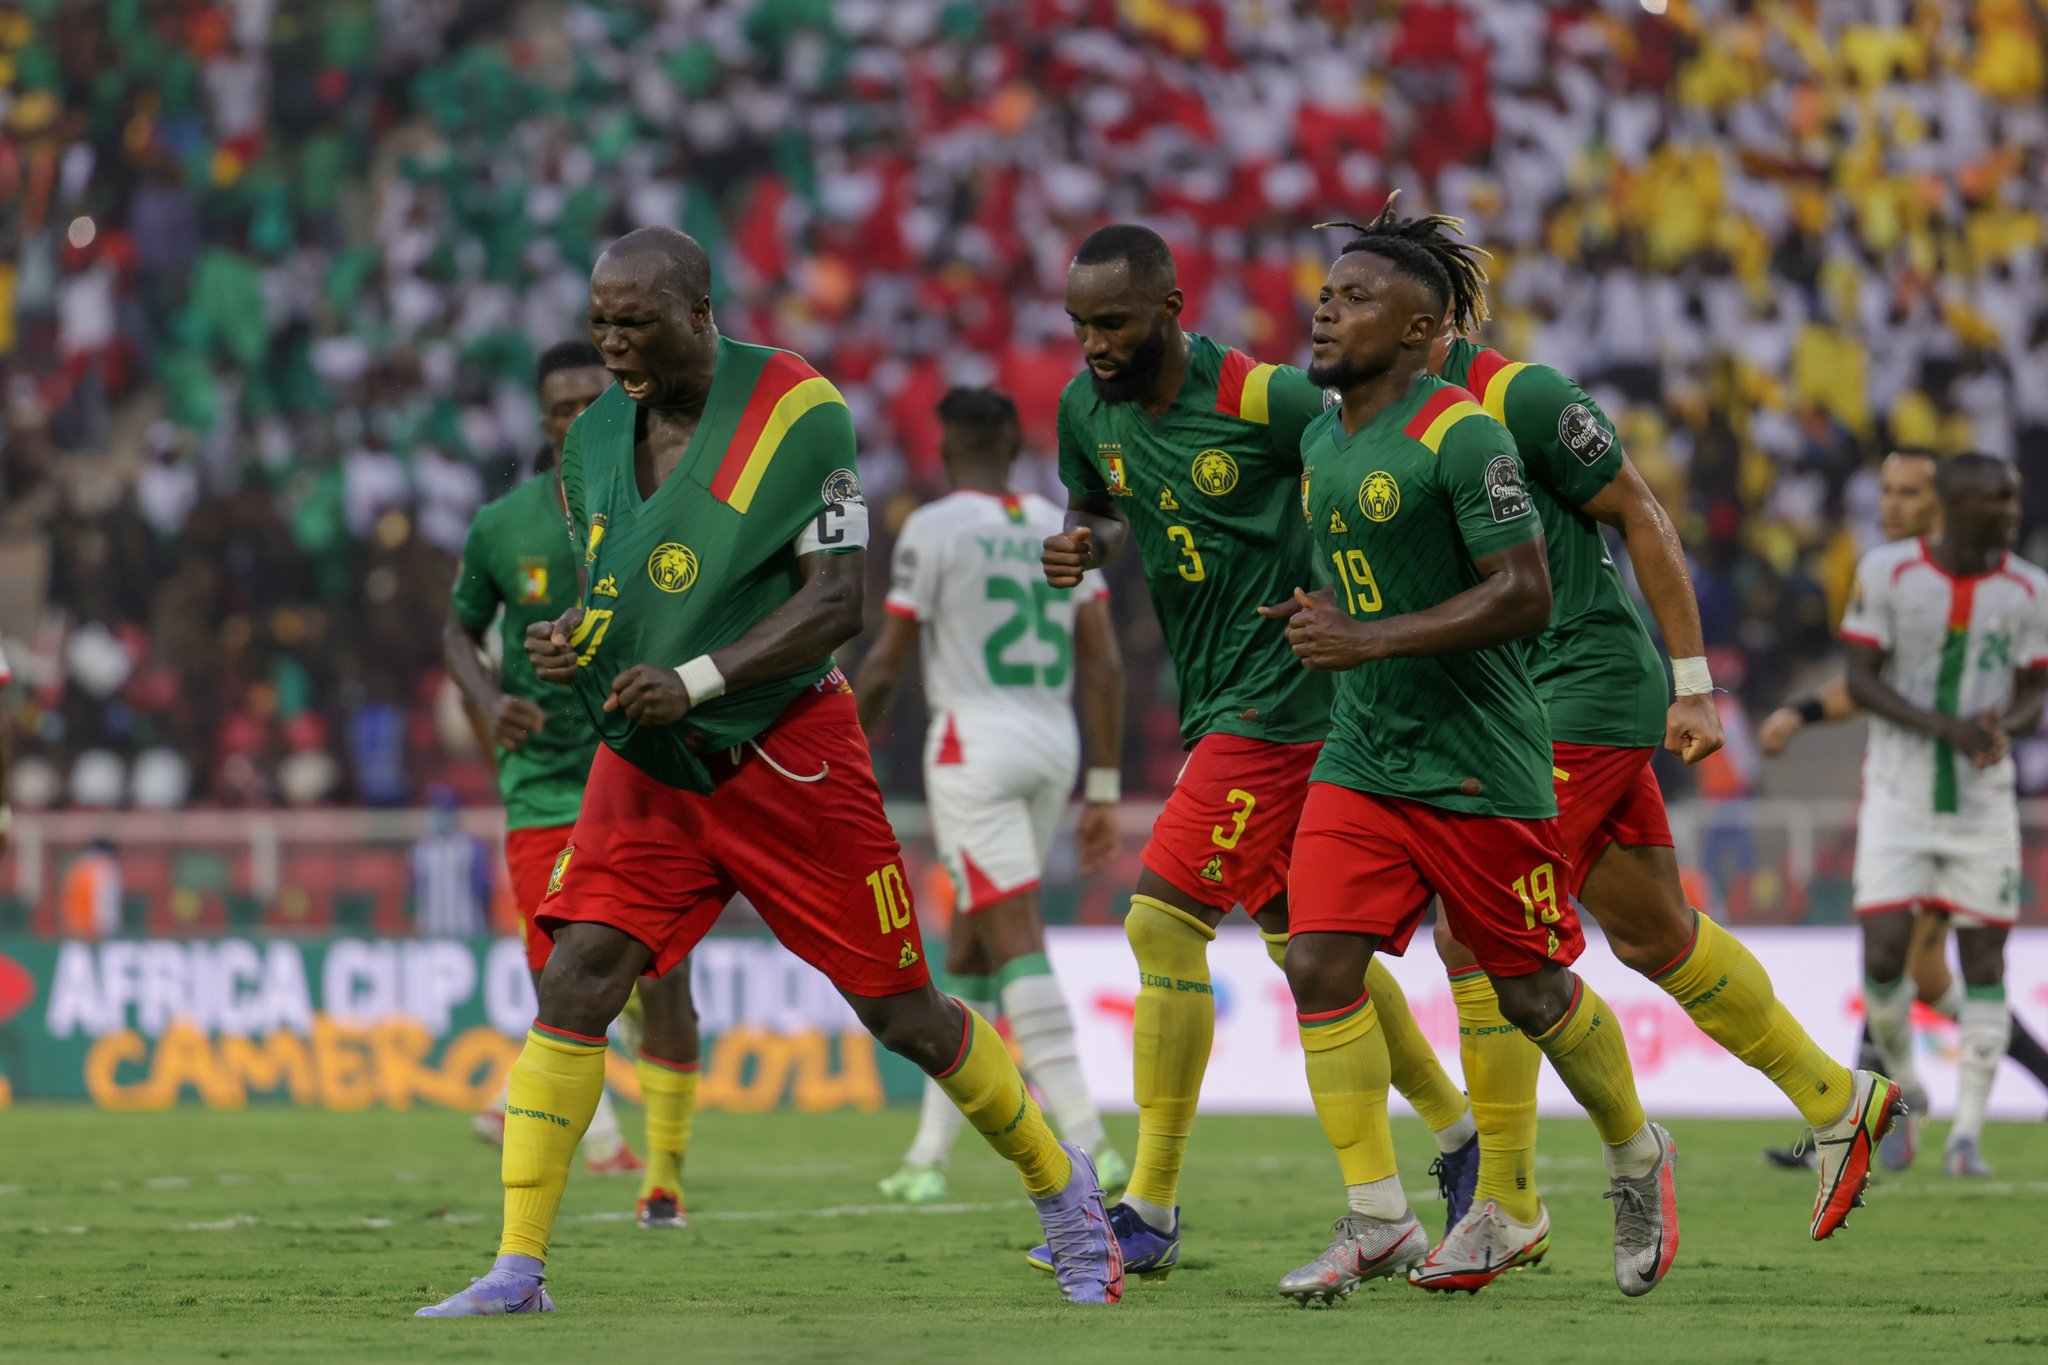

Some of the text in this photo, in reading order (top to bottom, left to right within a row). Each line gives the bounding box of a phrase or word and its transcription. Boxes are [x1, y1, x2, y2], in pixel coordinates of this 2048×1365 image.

[1588, 435, 1607, 457] CAF
[817, 504, 845, 544] C
[1167, 525, 1205, 582] 3
[1332, 549, 1383, 615] 19
[984, 576, 1073, 689] 25
[1211, 788, 1256, 849] 3
[865, 863, 911, 935] 10
[1512, 863, 1561, 931] 19
[45, 937, 313, 1040] AFRICA
[322, 936, 478, 1037] CUP
[508, 1105, 571, 1128] SPORTIF
